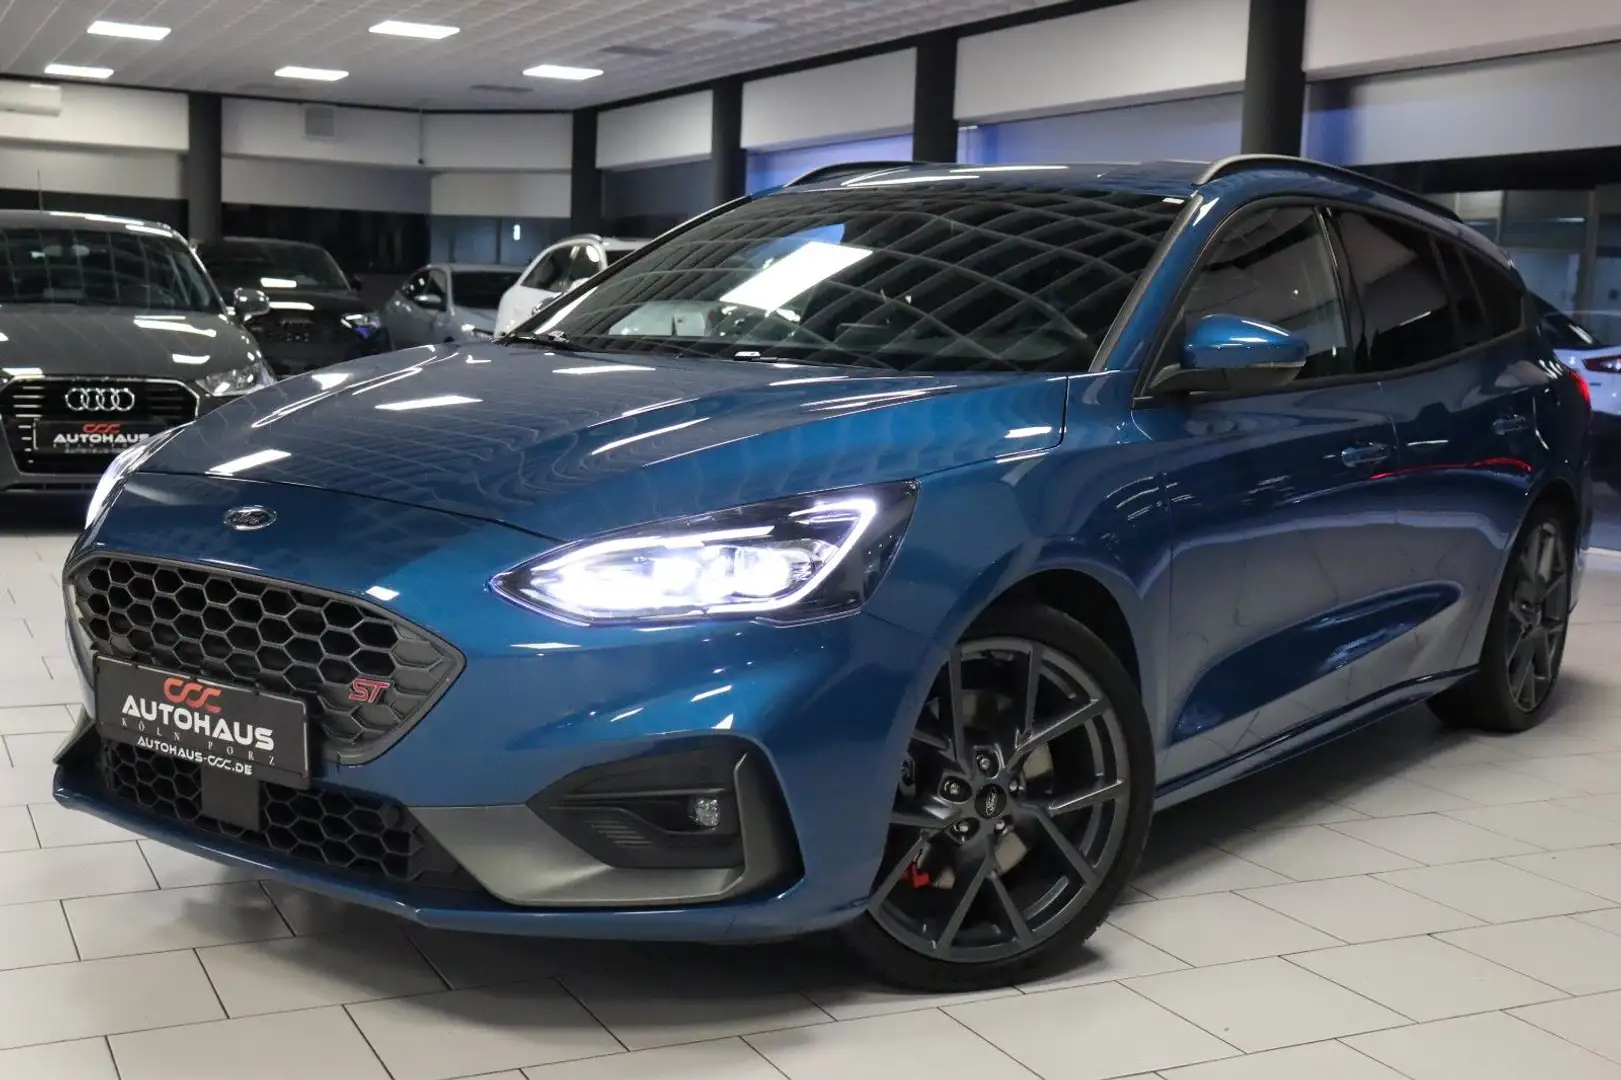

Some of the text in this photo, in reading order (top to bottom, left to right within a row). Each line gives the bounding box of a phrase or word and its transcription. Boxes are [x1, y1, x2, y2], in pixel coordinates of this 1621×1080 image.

[348, 677, 391, 703] ST
[121, 695, 275, 751] AUTOHAUS
[137, 736, 253, 775] AUTOHAUS-CCC.DE
[207, 740, 276, 767] PORZ
